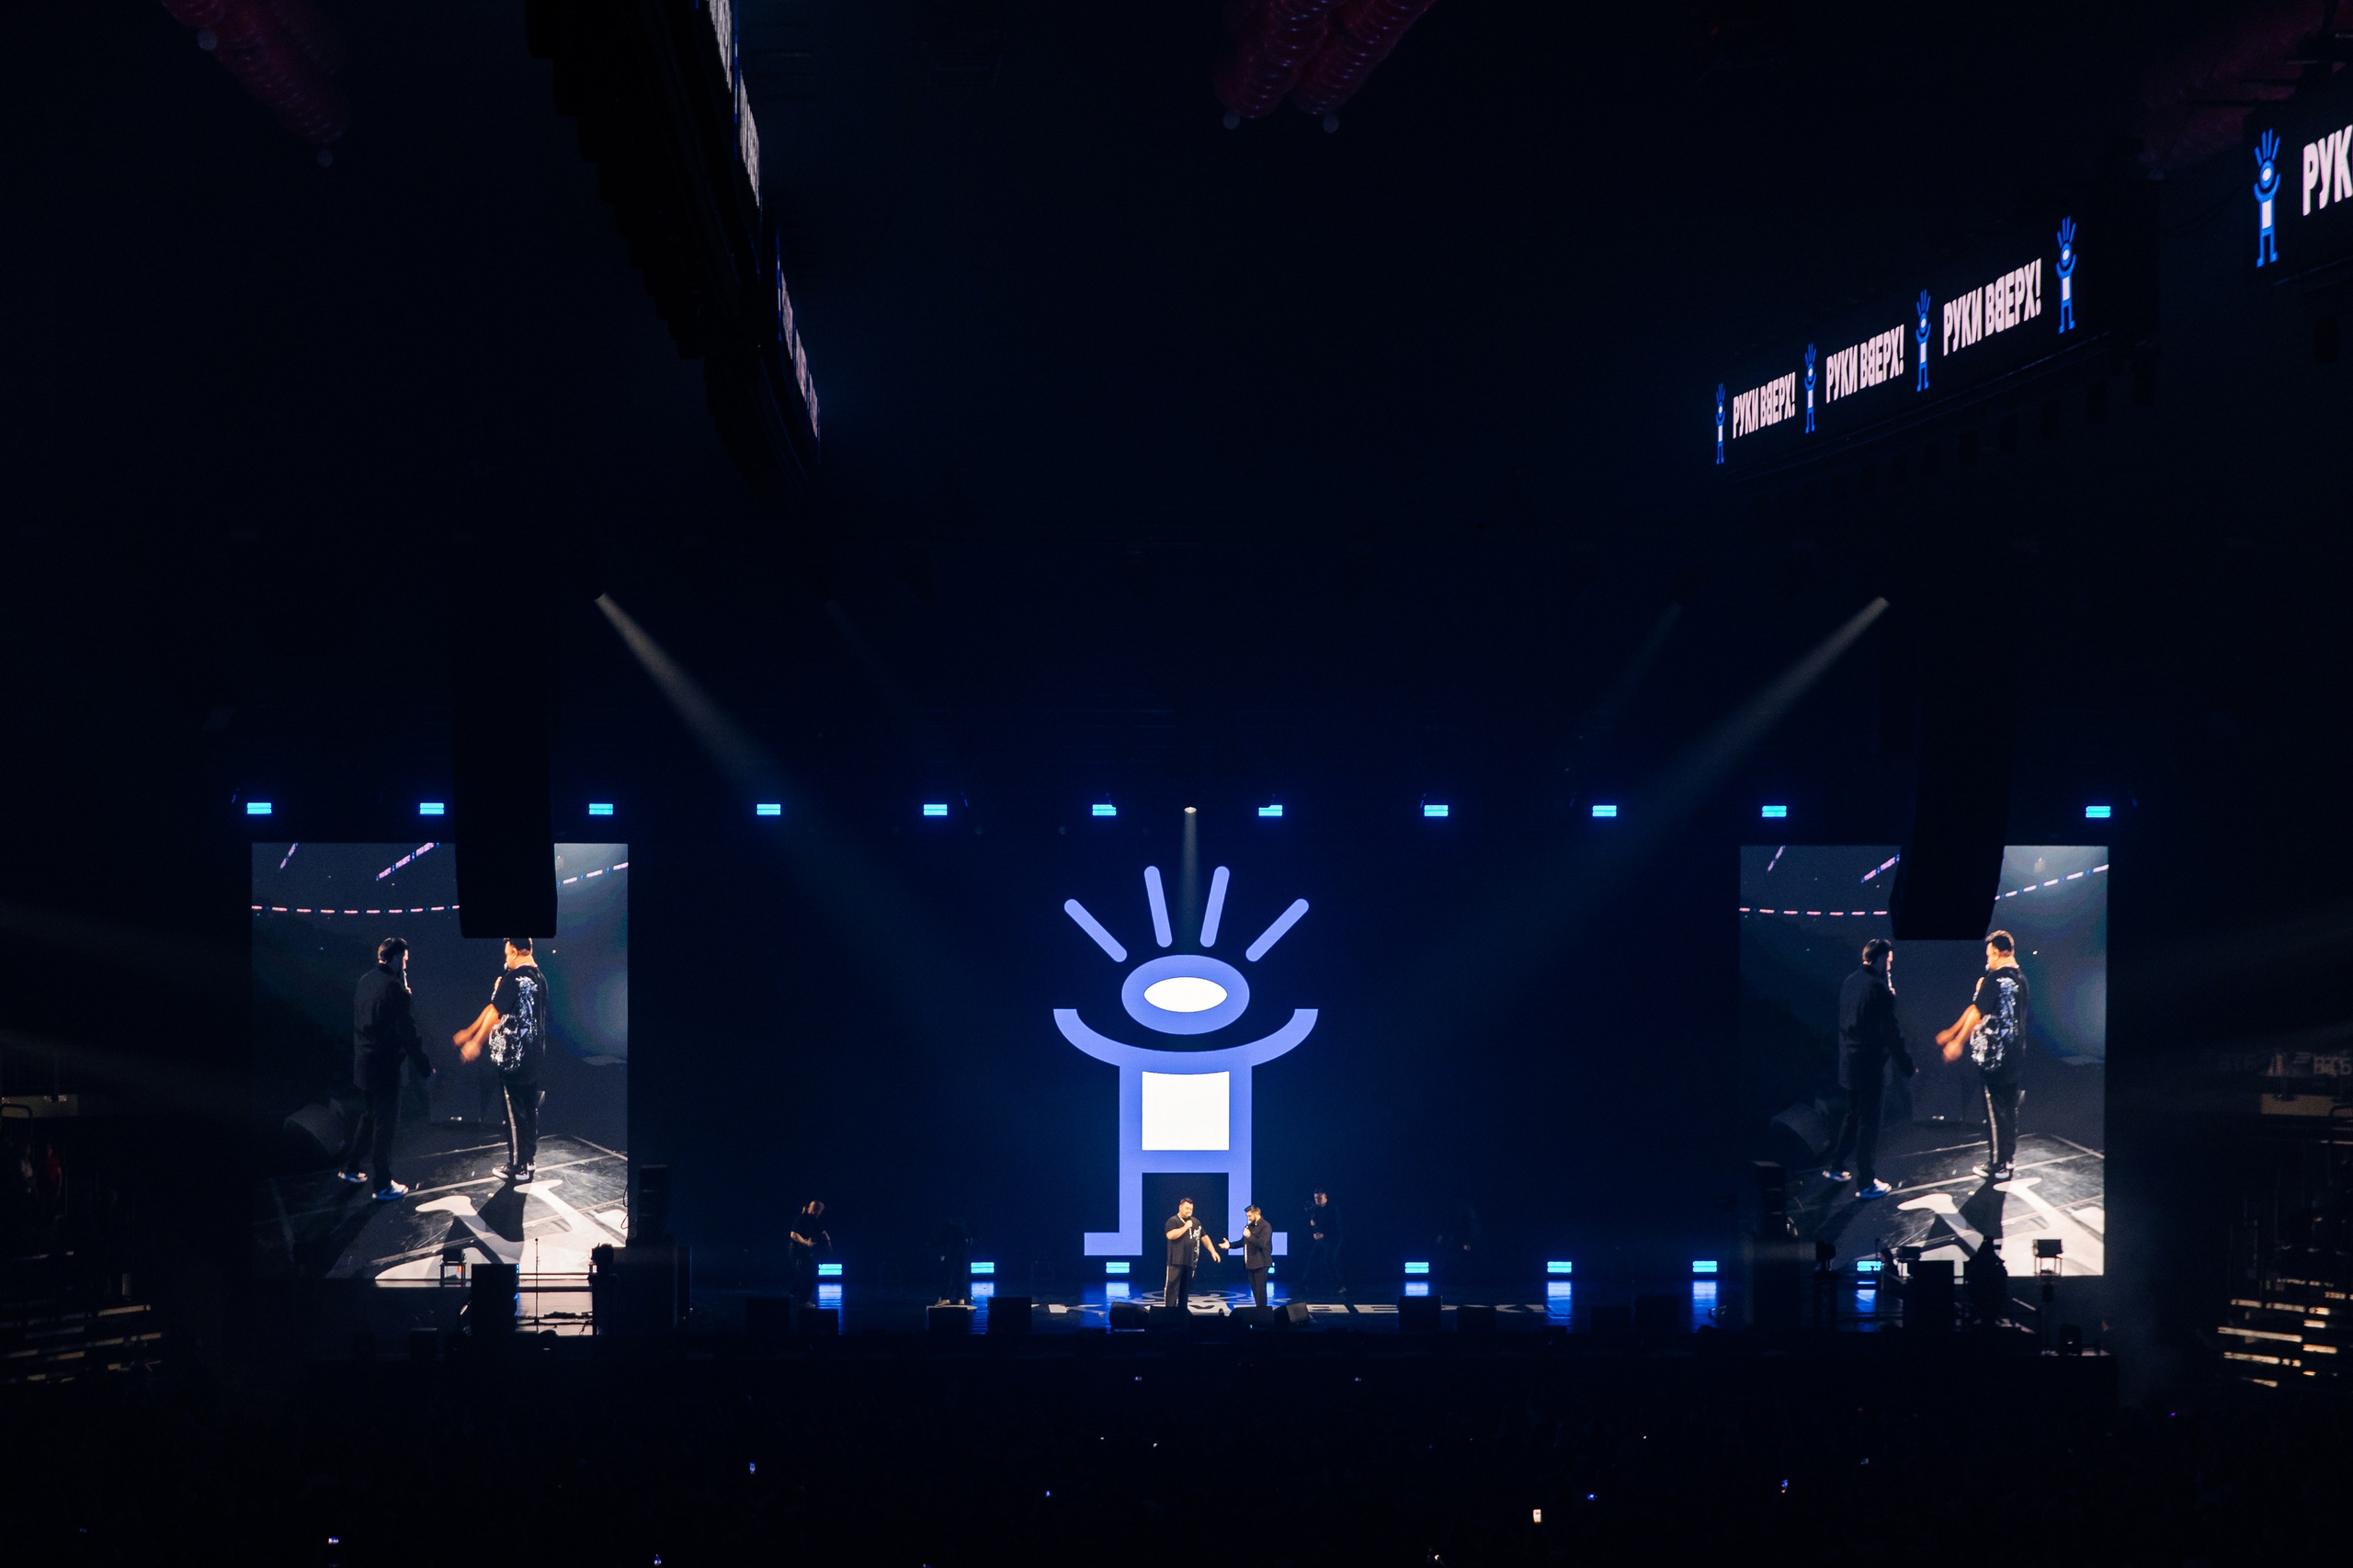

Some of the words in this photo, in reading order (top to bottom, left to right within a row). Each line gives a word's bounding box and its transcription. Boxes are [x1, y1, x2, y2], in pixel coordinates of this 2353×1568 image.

[2302, 124, 2353, 216] РУК
[1943, 286, 1983, 357] РУКИ
[1985, 257, 2041, 337] ВВЕРХ!
[1733, 388, 1759, 439] РУКИ
[1760, 371, 1796, 428] ВВЕРХ!
[1826, 344, 1859, 404] РУКИ
[1859, 324, 1904, 390] ВВЕРХ!
